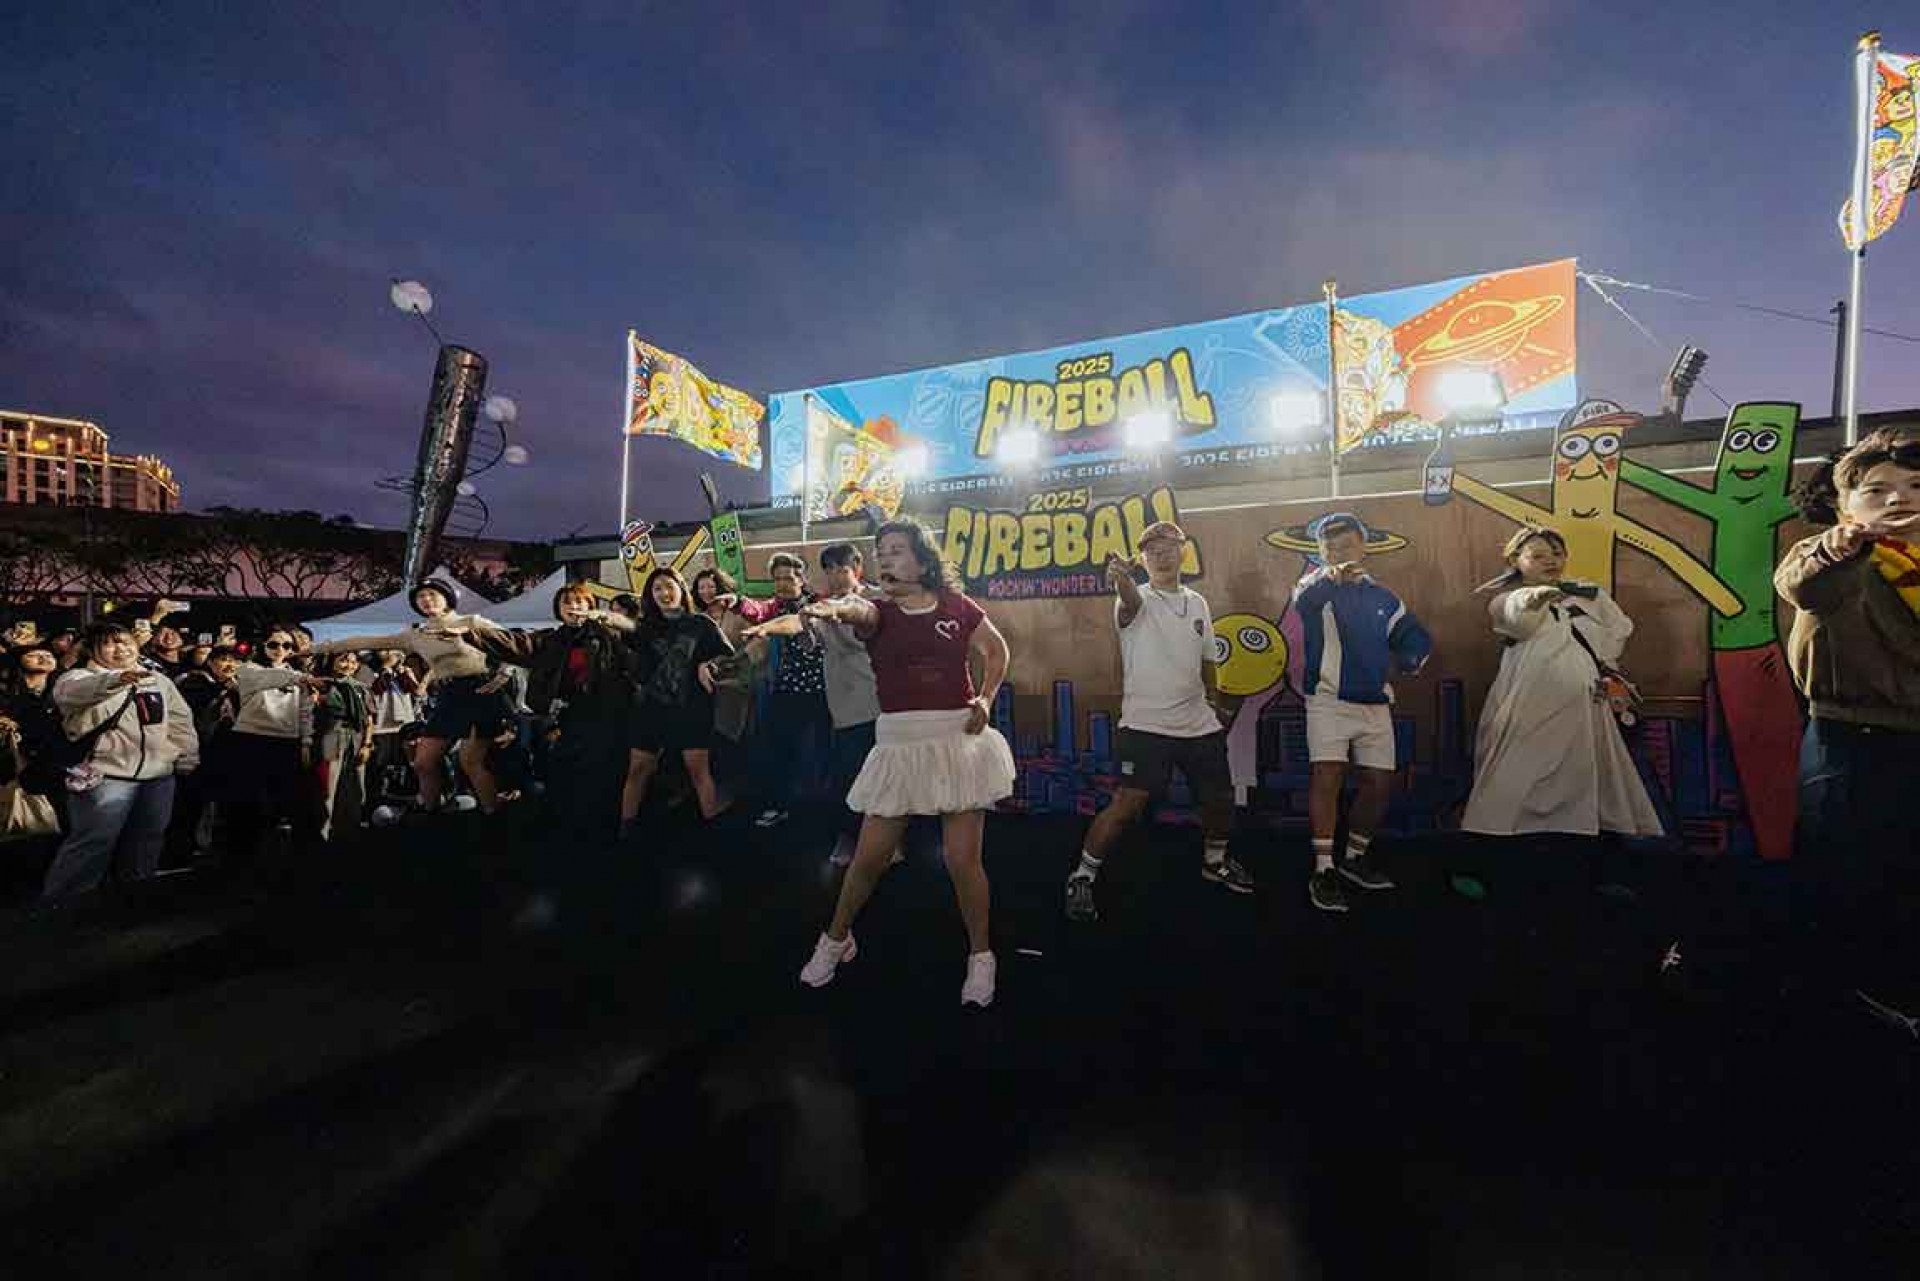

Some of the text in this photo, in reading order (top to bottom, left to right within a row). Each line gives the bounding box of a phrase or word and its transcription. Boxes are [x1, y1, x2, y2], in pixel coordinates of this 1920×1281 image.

[1057, 353, 1112, 381] 2025
[976, 347, 1216, 458] FIREBALL
[1029, 488, 1089, 511] 2025
